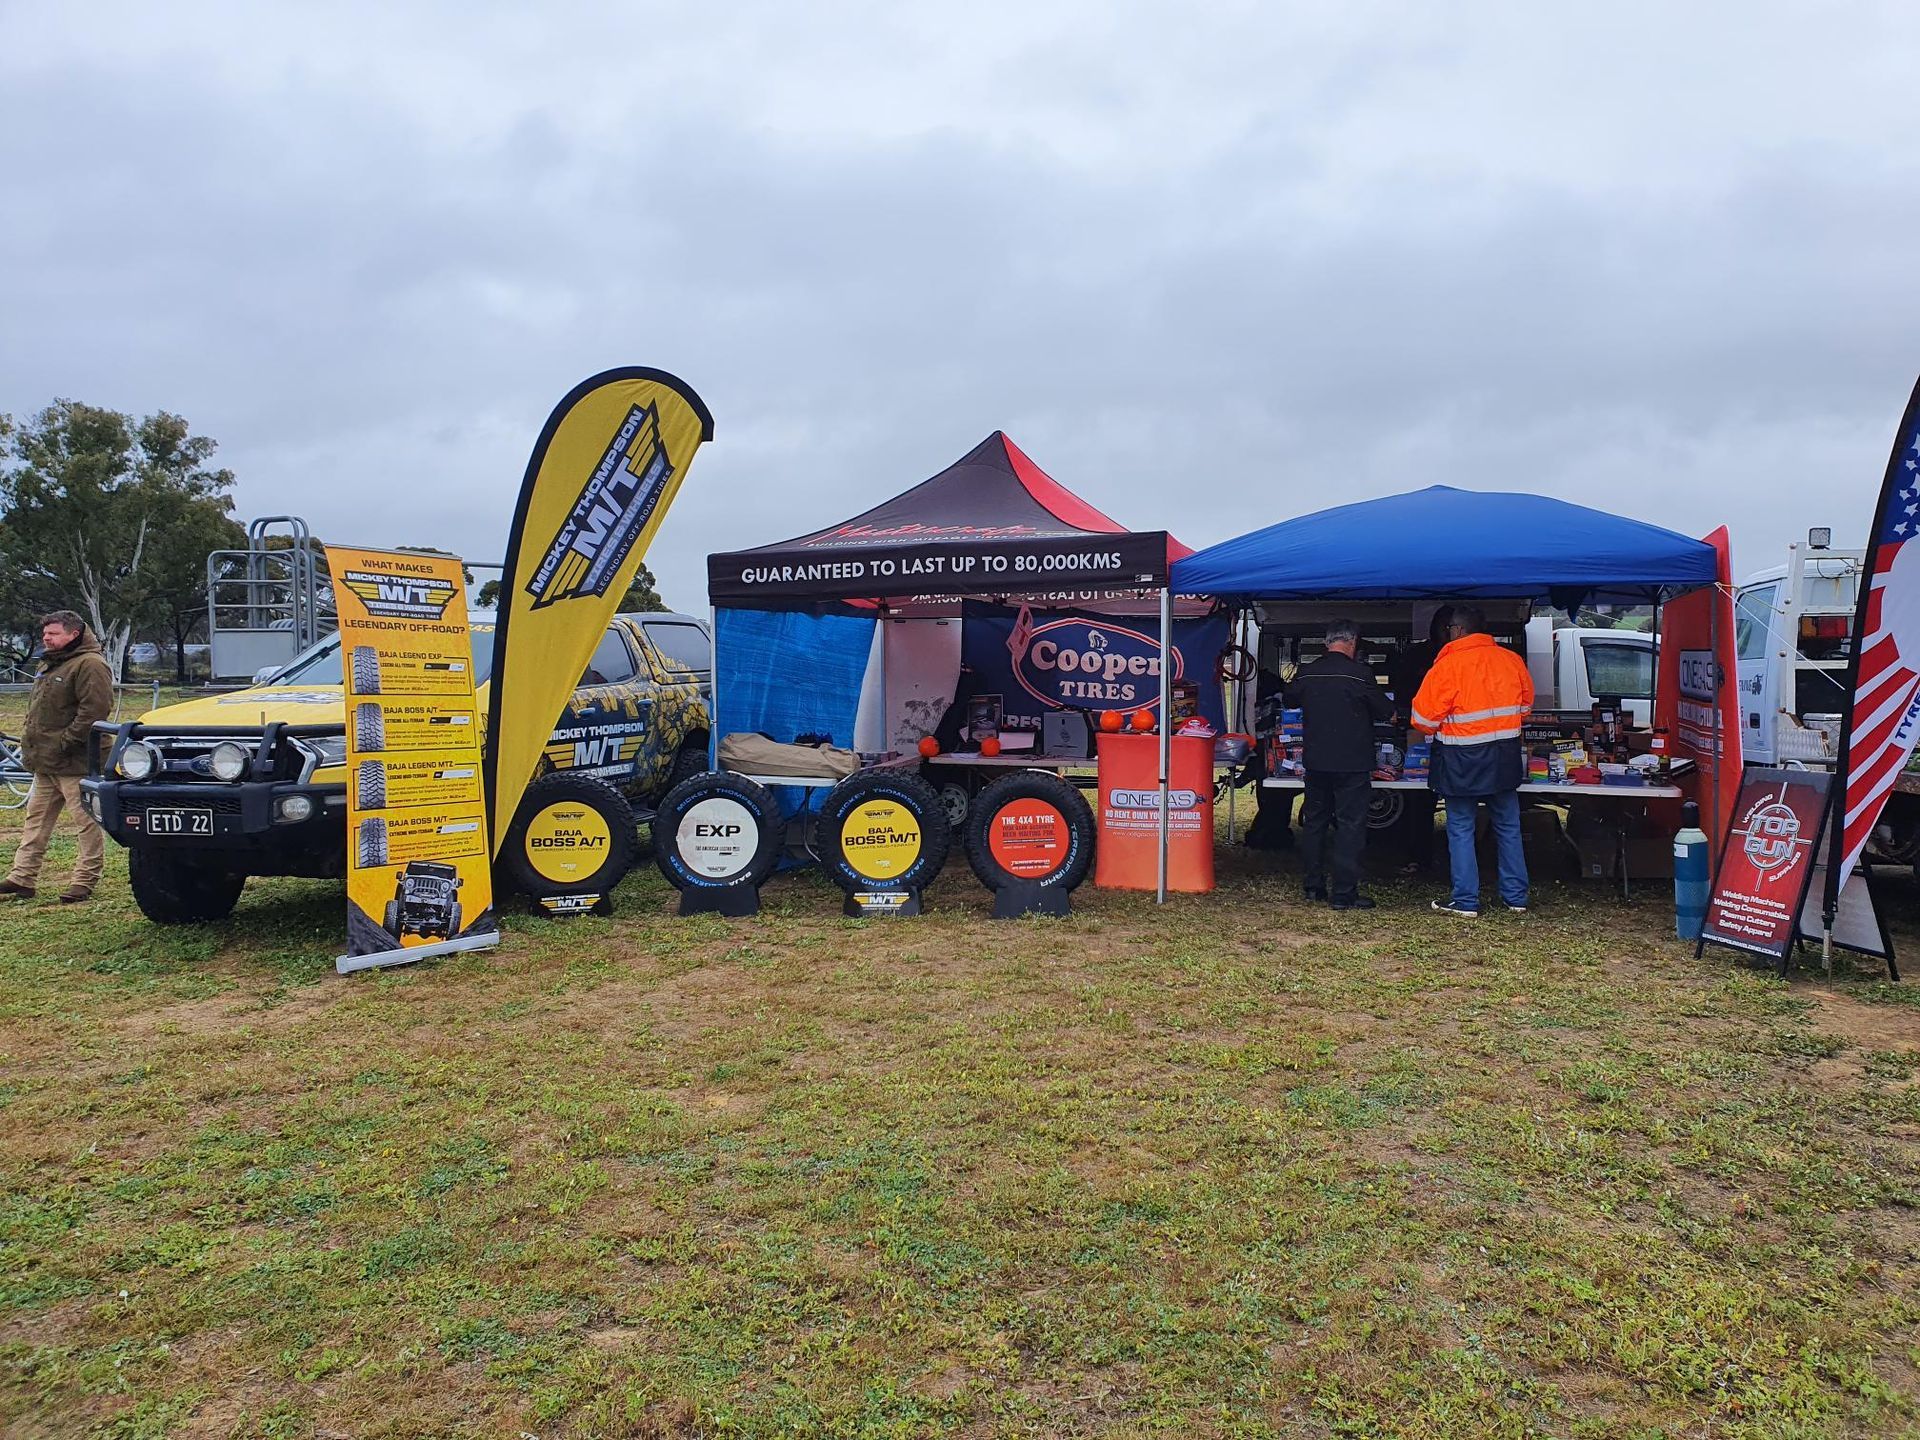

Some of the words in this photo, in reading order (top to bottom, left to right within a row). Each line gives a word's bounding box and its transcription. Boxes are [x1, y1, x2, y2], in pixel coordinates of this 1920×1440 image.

[531, 519, 577, 594] MICKEY
[573, 409, 644, 518] THOMPSON
[622, 462, 660, 524] WHEELS
[572, 456, 639, 559] M/T
[598, 541, 630, 592] LEGENDARY
[628, 496, 657, 541] OFF-ROAD
[655, 470, 672, 496] TIRES
[361, 559, 393, 570] WHAT
[395, 562, 434, 574] MAKES
[741, 561, 864, 584] GUARANTEED
[869, 560, 896, 576] TO
[901, 557, 946, 575] LAST
[951, 556, 976, 573] UP
[982, 556, 1008, 572] TO
[1014, 552, 1122, 574] 80,000KMS
[347, 572, 389, 583] MICKEY
[390, 576, 451, 588] THOMPSON
[378, 584, 432, 604] M/T
[344, 619, 407, 632] LEGENDARY
[410, 623, 466, 634] OFF-ROAD?
[399, 652, 426, 660] LEGEND
[1031, 640, 1161, 681] Cooper
[1059, 681, 1135, 700] TIRES
[1895, 688, 1920, 739] TYRE
[588, 722, 644, 737] THOMPSON
[573, 736, 625, 766] M/T
[408, 762, 437, 770] LEGEND
[677, 788, 709, 812] MICKEY
[715, 788, 762, 816] THOMPSON
[836, 790, 866, 818] MICKEY
[872, 788, 923, 815] THOMPSON
[1116, 792, 1192, 806] ONEGAS
[1105, 810, 1113, 818] NO
[1114, 810, 1132, 819] RENT.
[1132, 811, 1148, 819] OWN
[1742, 793, 1774, 824] WELDING
[152, 814, 182, 832] ETD
[192, 815, 209, 832] 22
[388, 819, 410, 828] BAJA
[410, 817, 432, 826] BOSS
[1002, 816, 1016, 825] THE
[1018, 816, 1033, 824] 4X4
[1036, 814, 1054, 824] TYRE
[1752, 814, 1800, 836] TOP
[695, 824, 741, 838] EXP
[845, 834, 886, 846] BOSS
[890, 832, 918, 844] M/T
[531, 838, 576, 848] BOSS
[578, 836, 606, 847] A/T
[1744, 837, 1796, 860] GUN
[670, 855, 684, 875] EXP
[840, 862, 857, 880] MTZ
[904, 858, 925, 880] BAJA
[728, 871, 752, 886] BAJA
[862, 878, 900, 887] LEGEND
[557, 898, 588, 907] M/T
[870, 896, 896, 904] M/T
[1722, 890, 1750, 904] Welding
[1750, 893, 1786, 910] Machines
[1714, 898, 1741, 912] Welding
[1740, 903, 1790, 921] Consumables
[1720, 910, 1747, 922] Plasma
[1746, 915, 1776, 928] Cutters
[1718, 920, 1743, 933] Safety
[1742, 924, 1774, 938] Apparel
